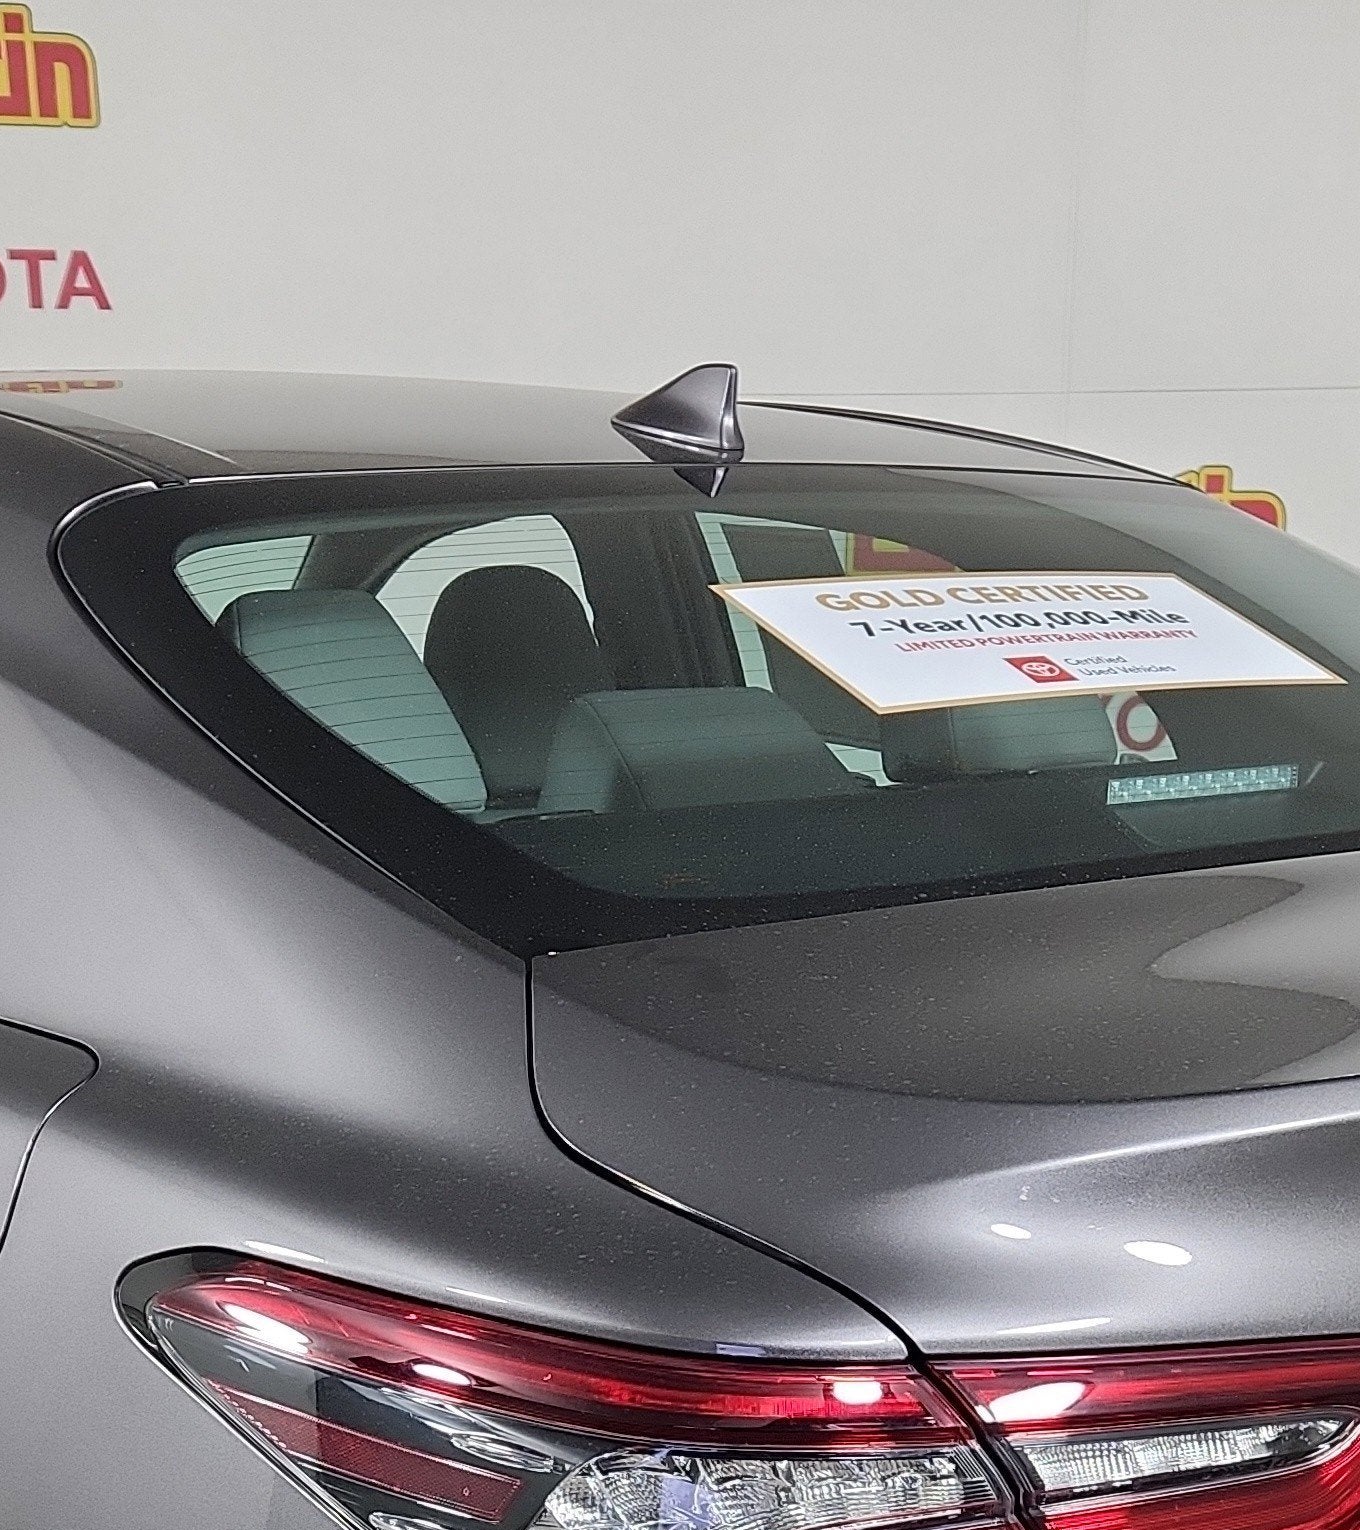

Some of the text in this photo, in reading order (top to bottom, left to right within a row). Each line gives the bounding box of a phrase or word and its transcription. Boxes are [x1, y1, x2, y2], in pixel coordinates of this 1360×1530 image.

[815, 585, 1150, 612] GOLD CERTIFIED
[849, 608, 1191, 637] 7-Year/100,000-Mile
[894, 629, 1199, 653] LIMITED POWERTRAIN WARRANTY
[1064, 655, 1128, 666] Certified
[1079, 663, 1177, 677] Used Vehicles
